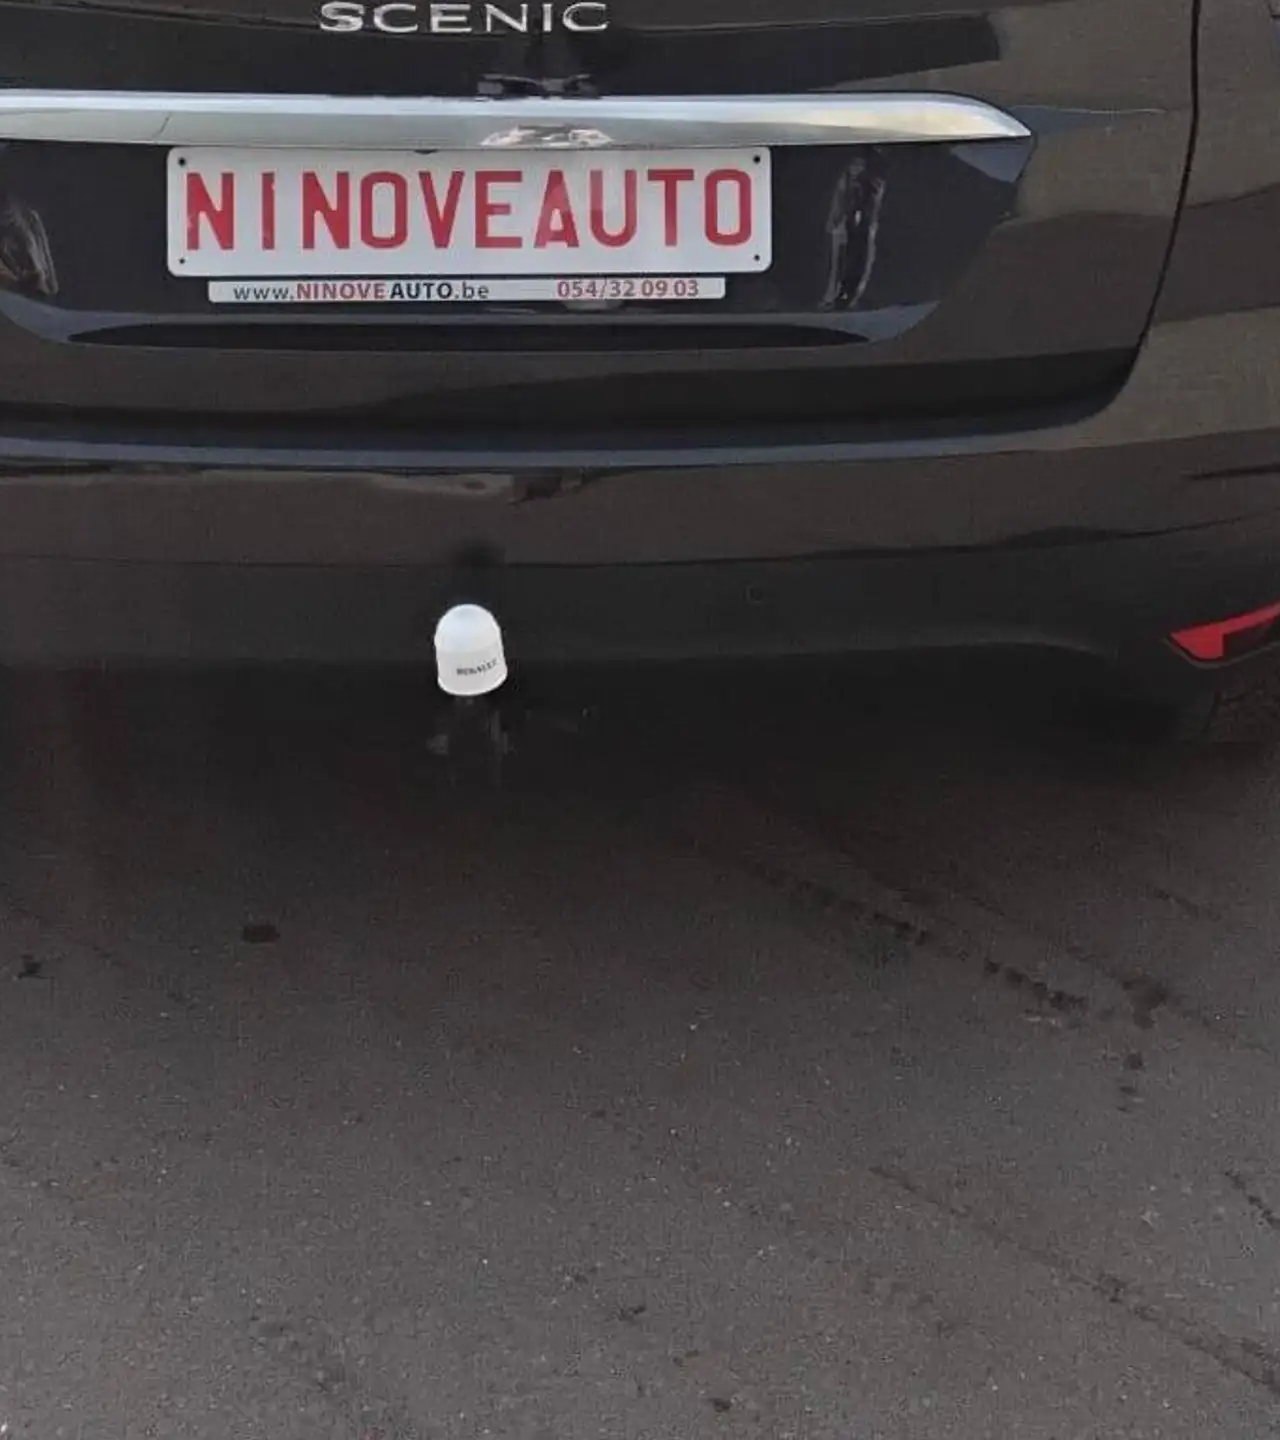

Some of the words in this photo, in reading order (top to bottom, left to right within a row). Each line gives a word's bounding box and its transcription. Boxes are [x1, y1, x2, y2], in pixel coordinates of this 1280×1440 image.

[320, 1, 608, 33] SCENIC
[186, 169, 752, 251] NINOVEAUTO
[557, 279, 635, 298] 054/32
[641, 279, 668, 297] 09
[674, 279, 700, 297] 03
